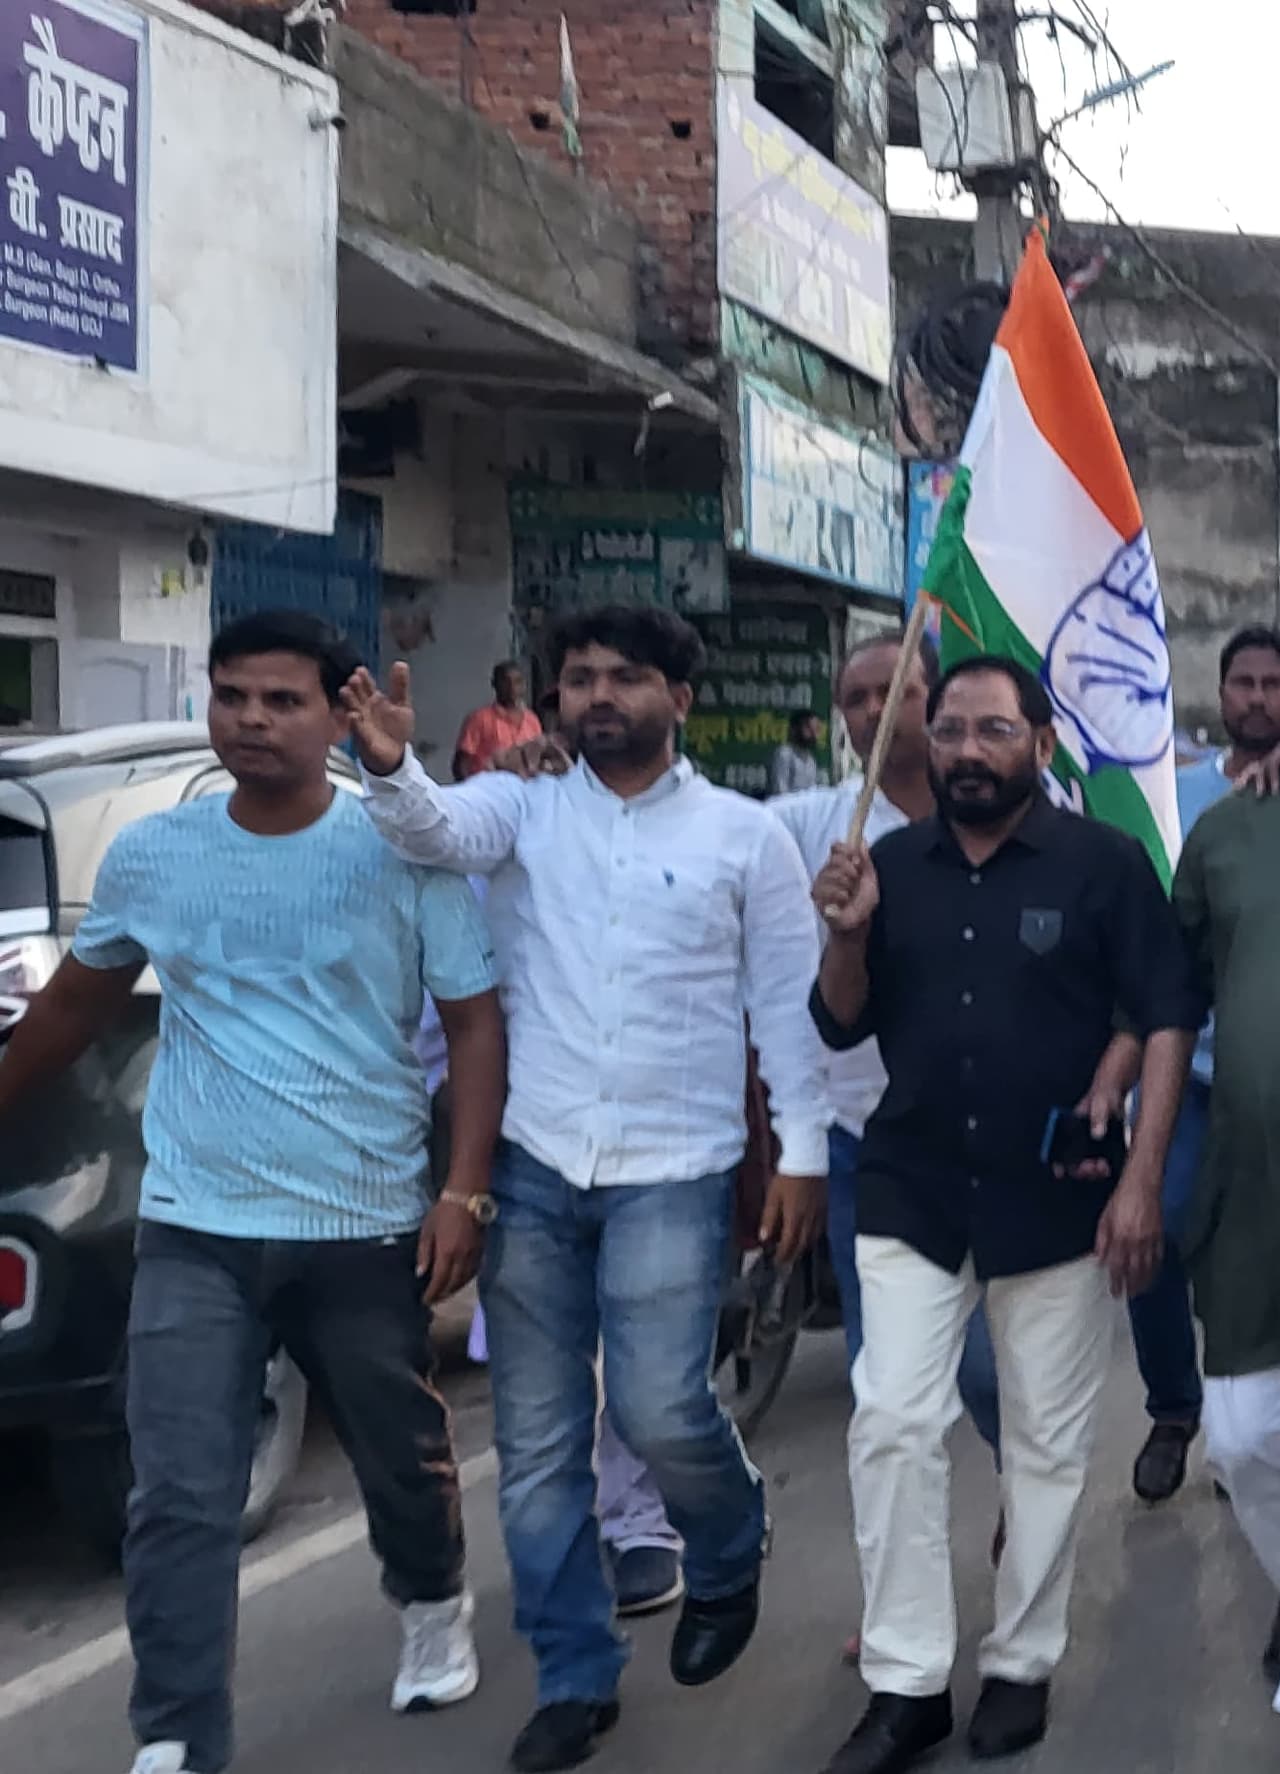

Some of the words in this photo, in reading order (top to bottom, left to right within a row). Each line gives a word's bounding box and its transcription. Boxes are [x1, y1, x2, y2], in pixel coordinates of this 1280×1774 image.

[23, 14, 129, 187] कैप्टन
[6, 166, 48, 239] वी.
[57, 193, 124, 265] प्रसाद
